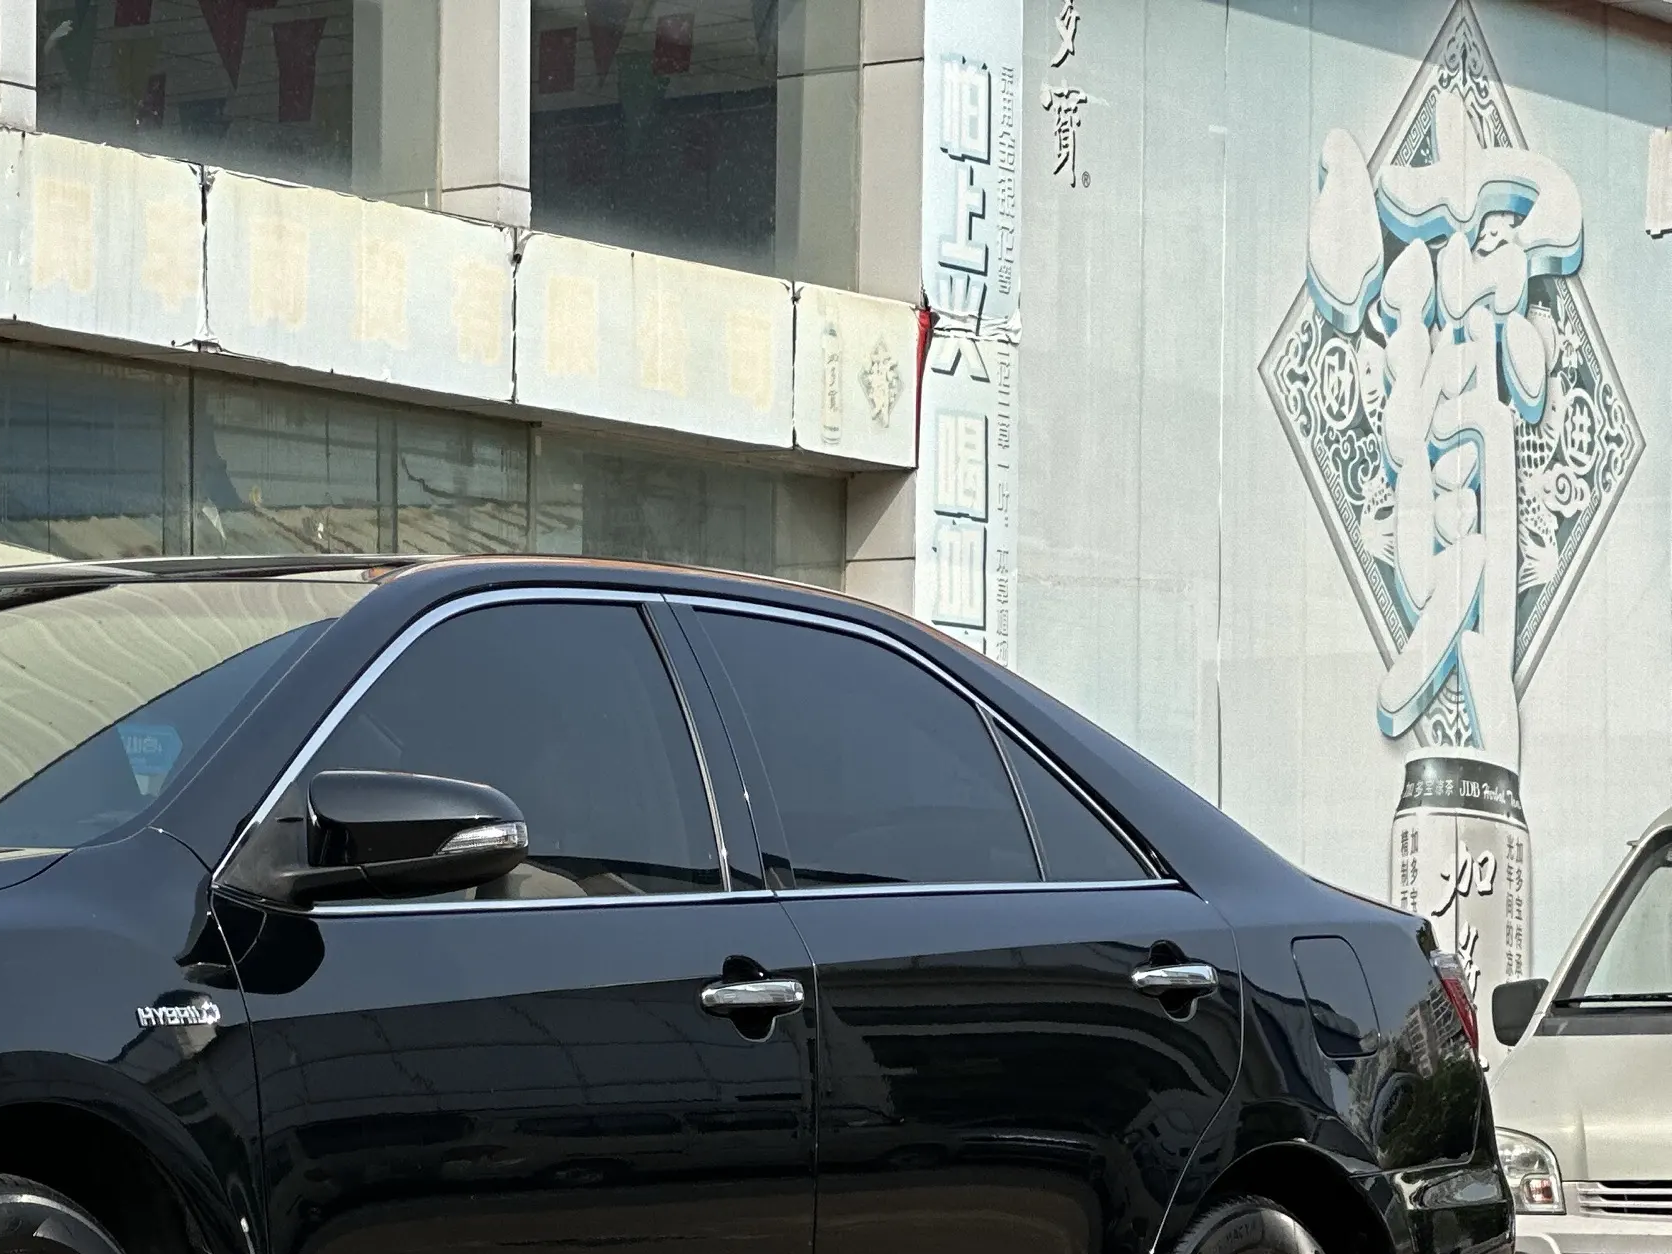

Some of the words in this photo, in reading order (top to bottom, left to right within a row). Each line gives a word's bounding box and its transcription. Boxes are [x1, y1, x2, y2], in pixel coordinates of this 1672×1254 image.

[932, 54, 990, 652] 怕上火喝加
[1459, 780, 1481, 798] JDB
[135, 1001, 221, 1027] HYBRID
